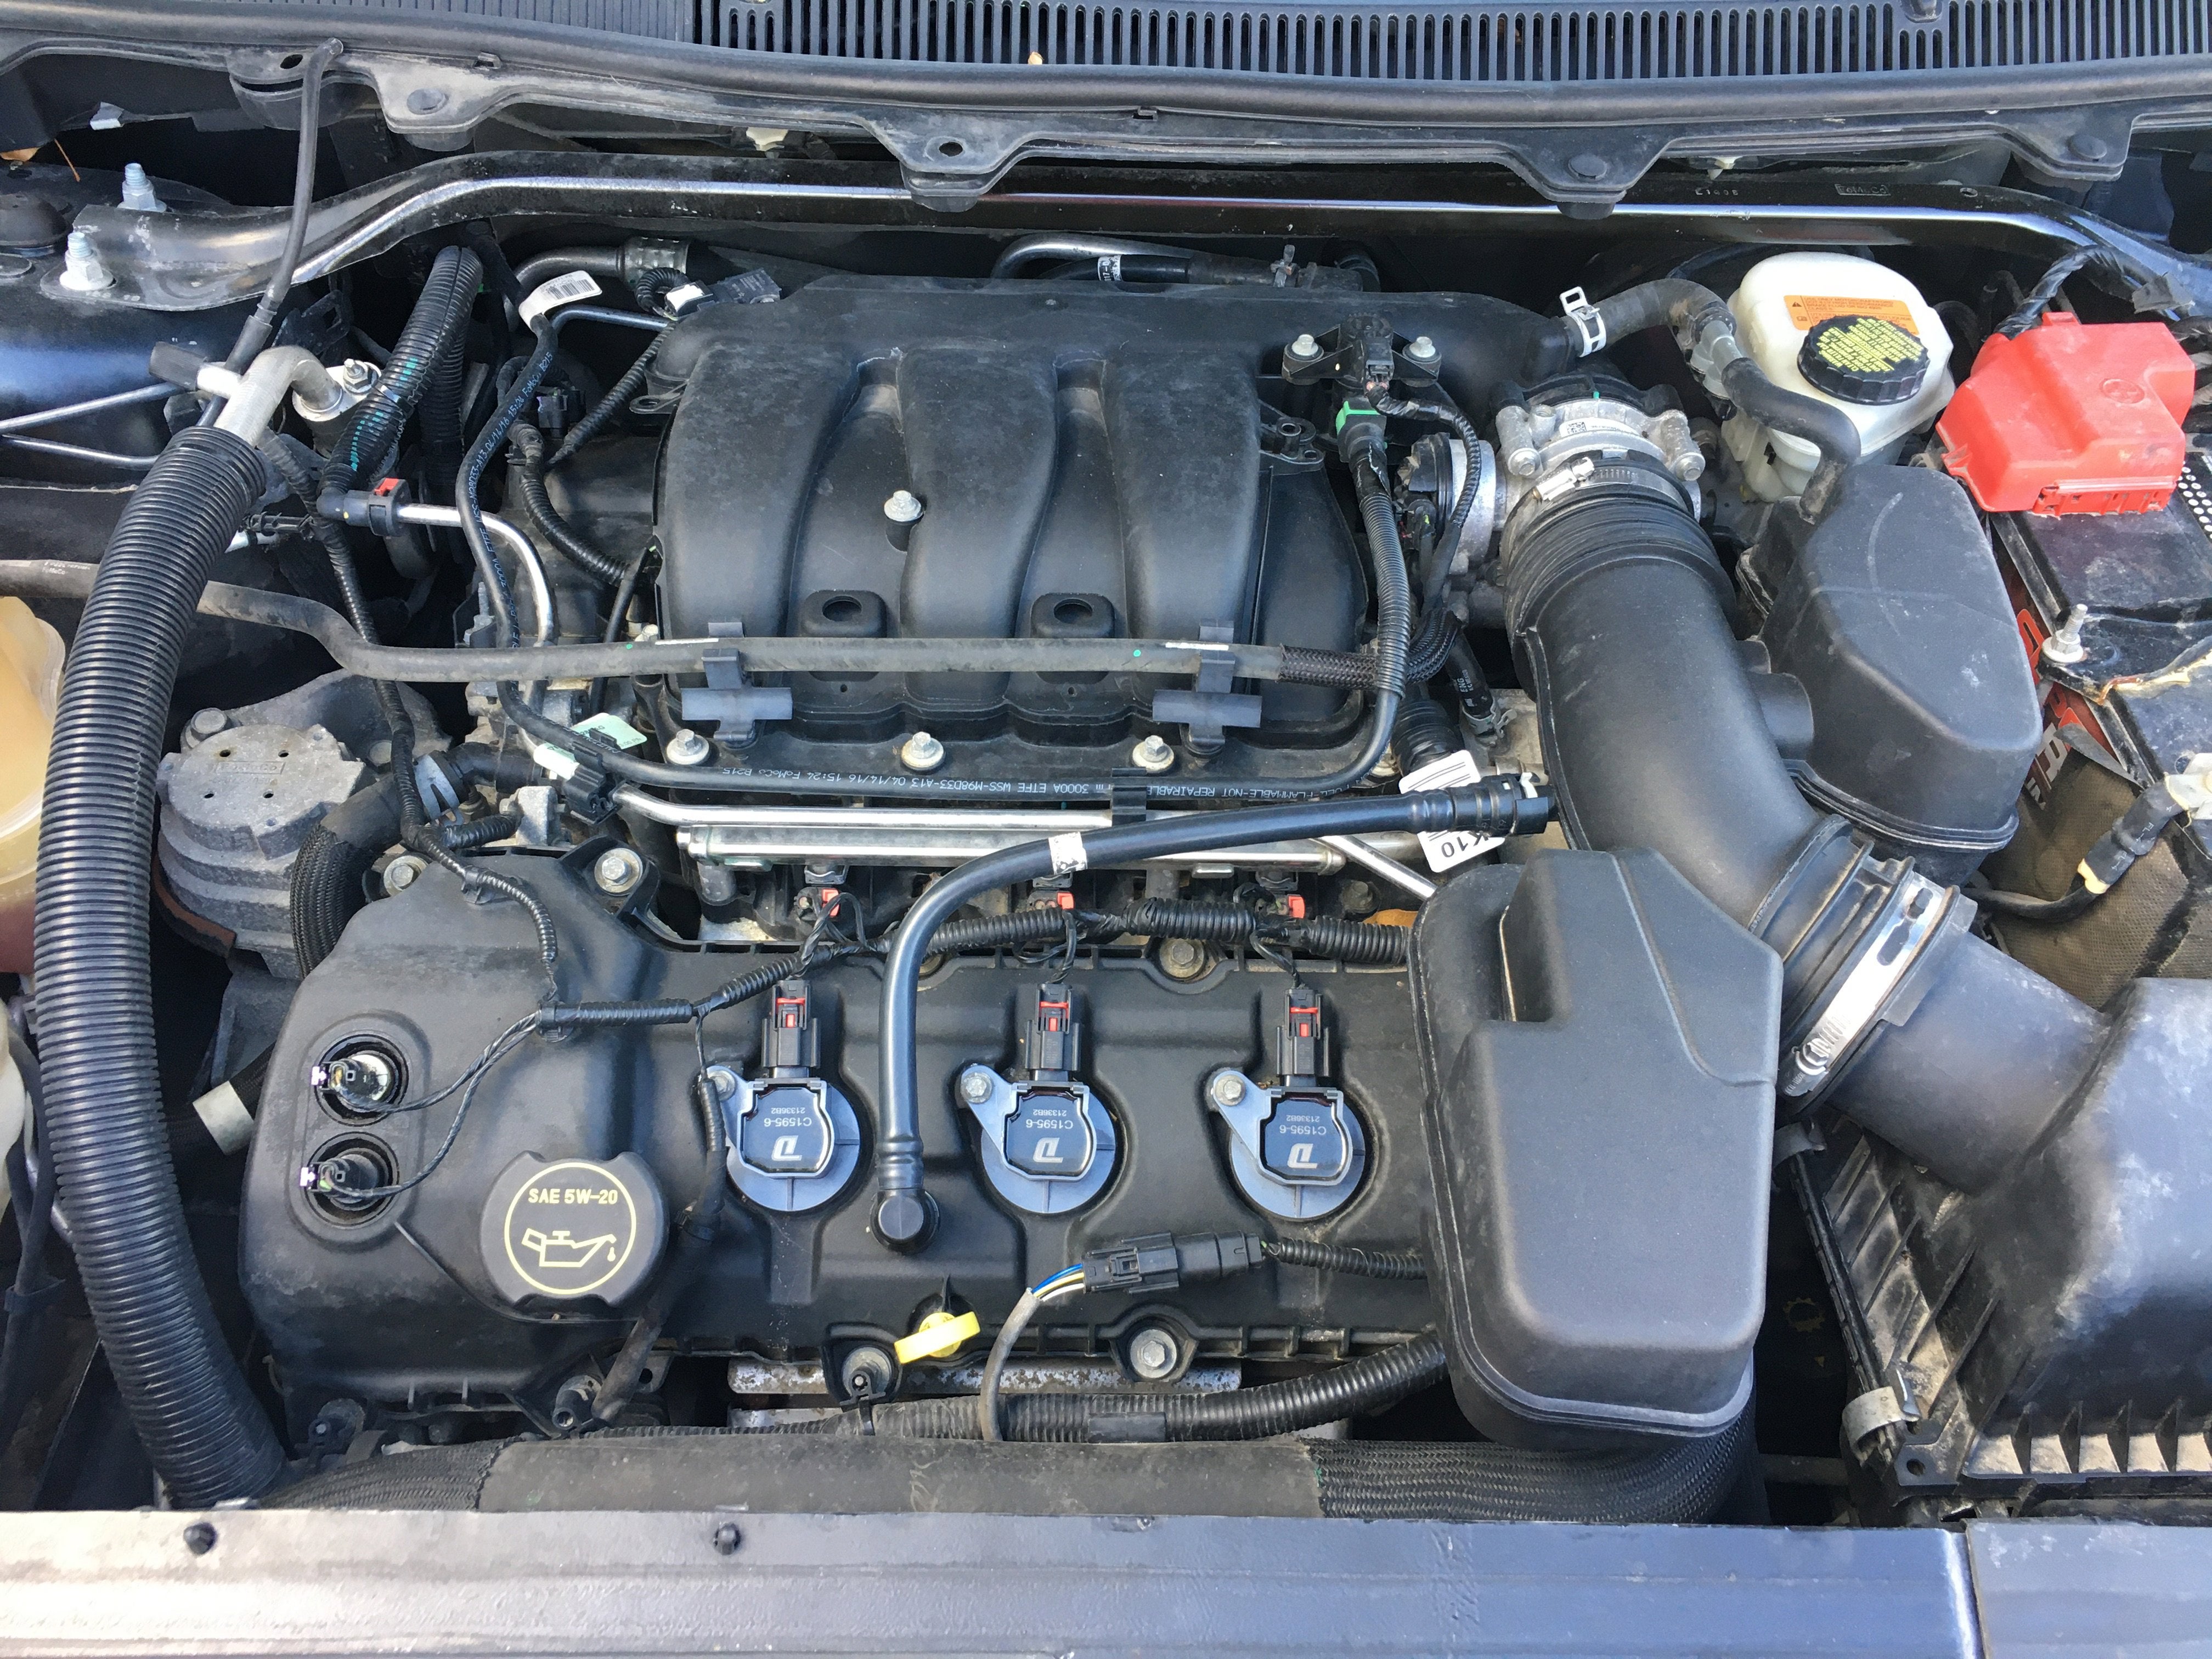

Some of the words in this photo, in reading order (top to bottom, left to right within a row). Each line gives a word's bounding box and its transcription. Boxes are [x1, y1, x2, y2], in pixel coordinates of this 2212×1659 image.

[1457, 678, 1468, 692] ENG
[723, 768, 752, 776] B215
[759, 769, 801, 780] FoMoCo
[807, 771, 842, 782] 15:24
[849, 774, 906, 786] 04/14/16
[912, 777, 1011, 792] WSS-M98D33-A13
[1018, 783, 1046, 793] ETFE
[1053, 783, 1089, 794] 3000A
[1147, 786, 1215, 797] REPAIRABLE
[764, 1117, 812, 1127] C1595-6
[1025, 1118, 1074, 1129] C1595-6
[1279, 1124, 1327, 1135] C1595-6
[528, 1188, 561, 1204] SAE
[564, 1188, 618, 1204] 5W-20
